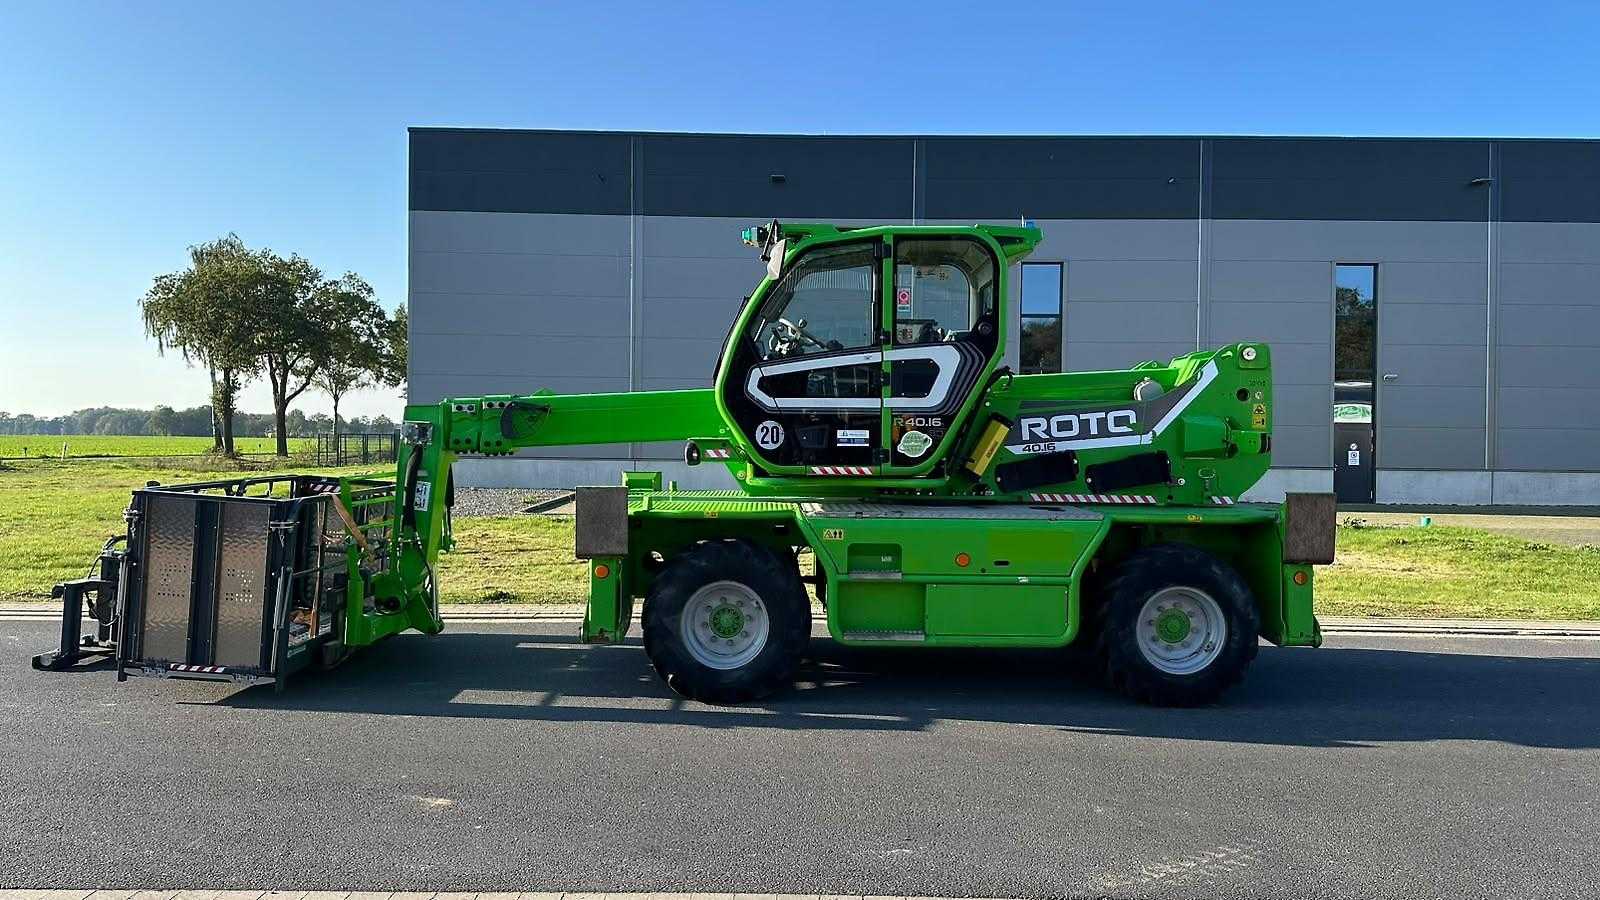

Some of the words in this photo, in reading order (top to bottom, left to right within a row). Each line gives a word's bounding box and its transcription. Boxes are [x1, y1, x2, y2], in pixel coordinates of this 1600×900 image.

[1020, 409, 1137, 441] ROTO
[760, 426, 780, 445] 20
[1022, 442, 1056, 453] 40.16
